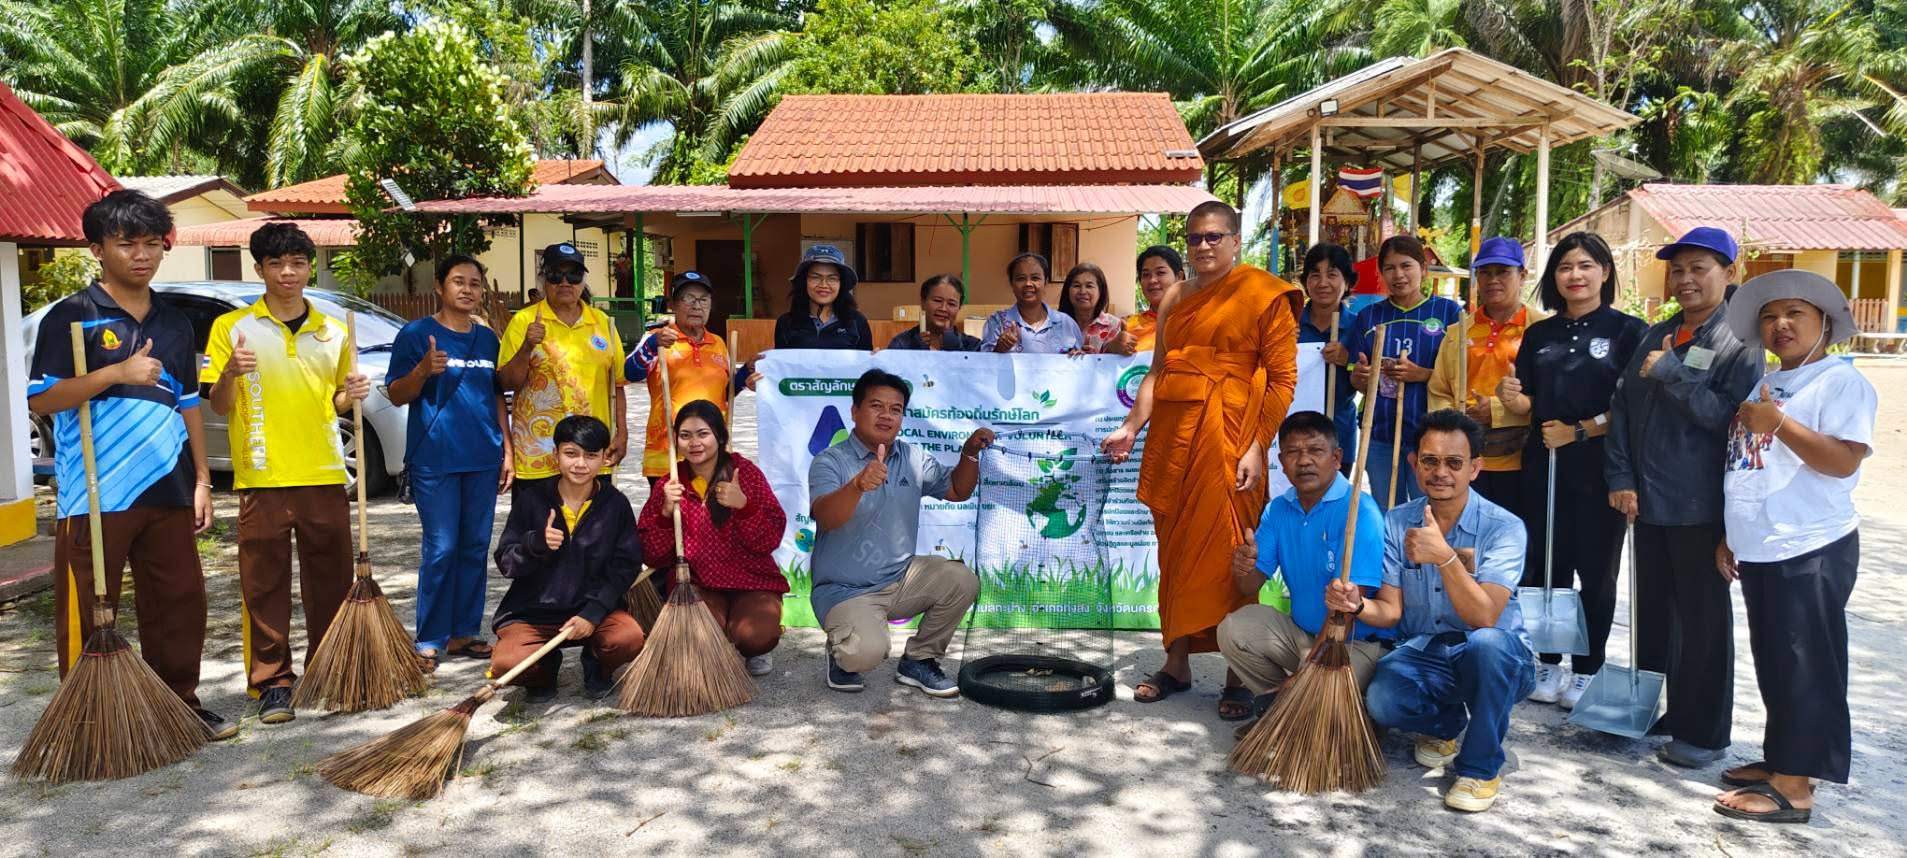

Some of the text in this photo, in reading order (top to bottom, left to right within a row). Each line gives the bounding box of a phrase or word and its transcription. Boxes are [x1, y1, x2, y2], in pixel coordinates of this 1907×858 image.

[1395, 338, 1413, 355] 13
[248, 372, 268, 470] SOUTHERN
[903, 404, 1040, 421] าสมัครท้องถิ่นรักษ์โลก
[897, 428, 924, 438] OCAL
[921, 442, 942, 453] THE
